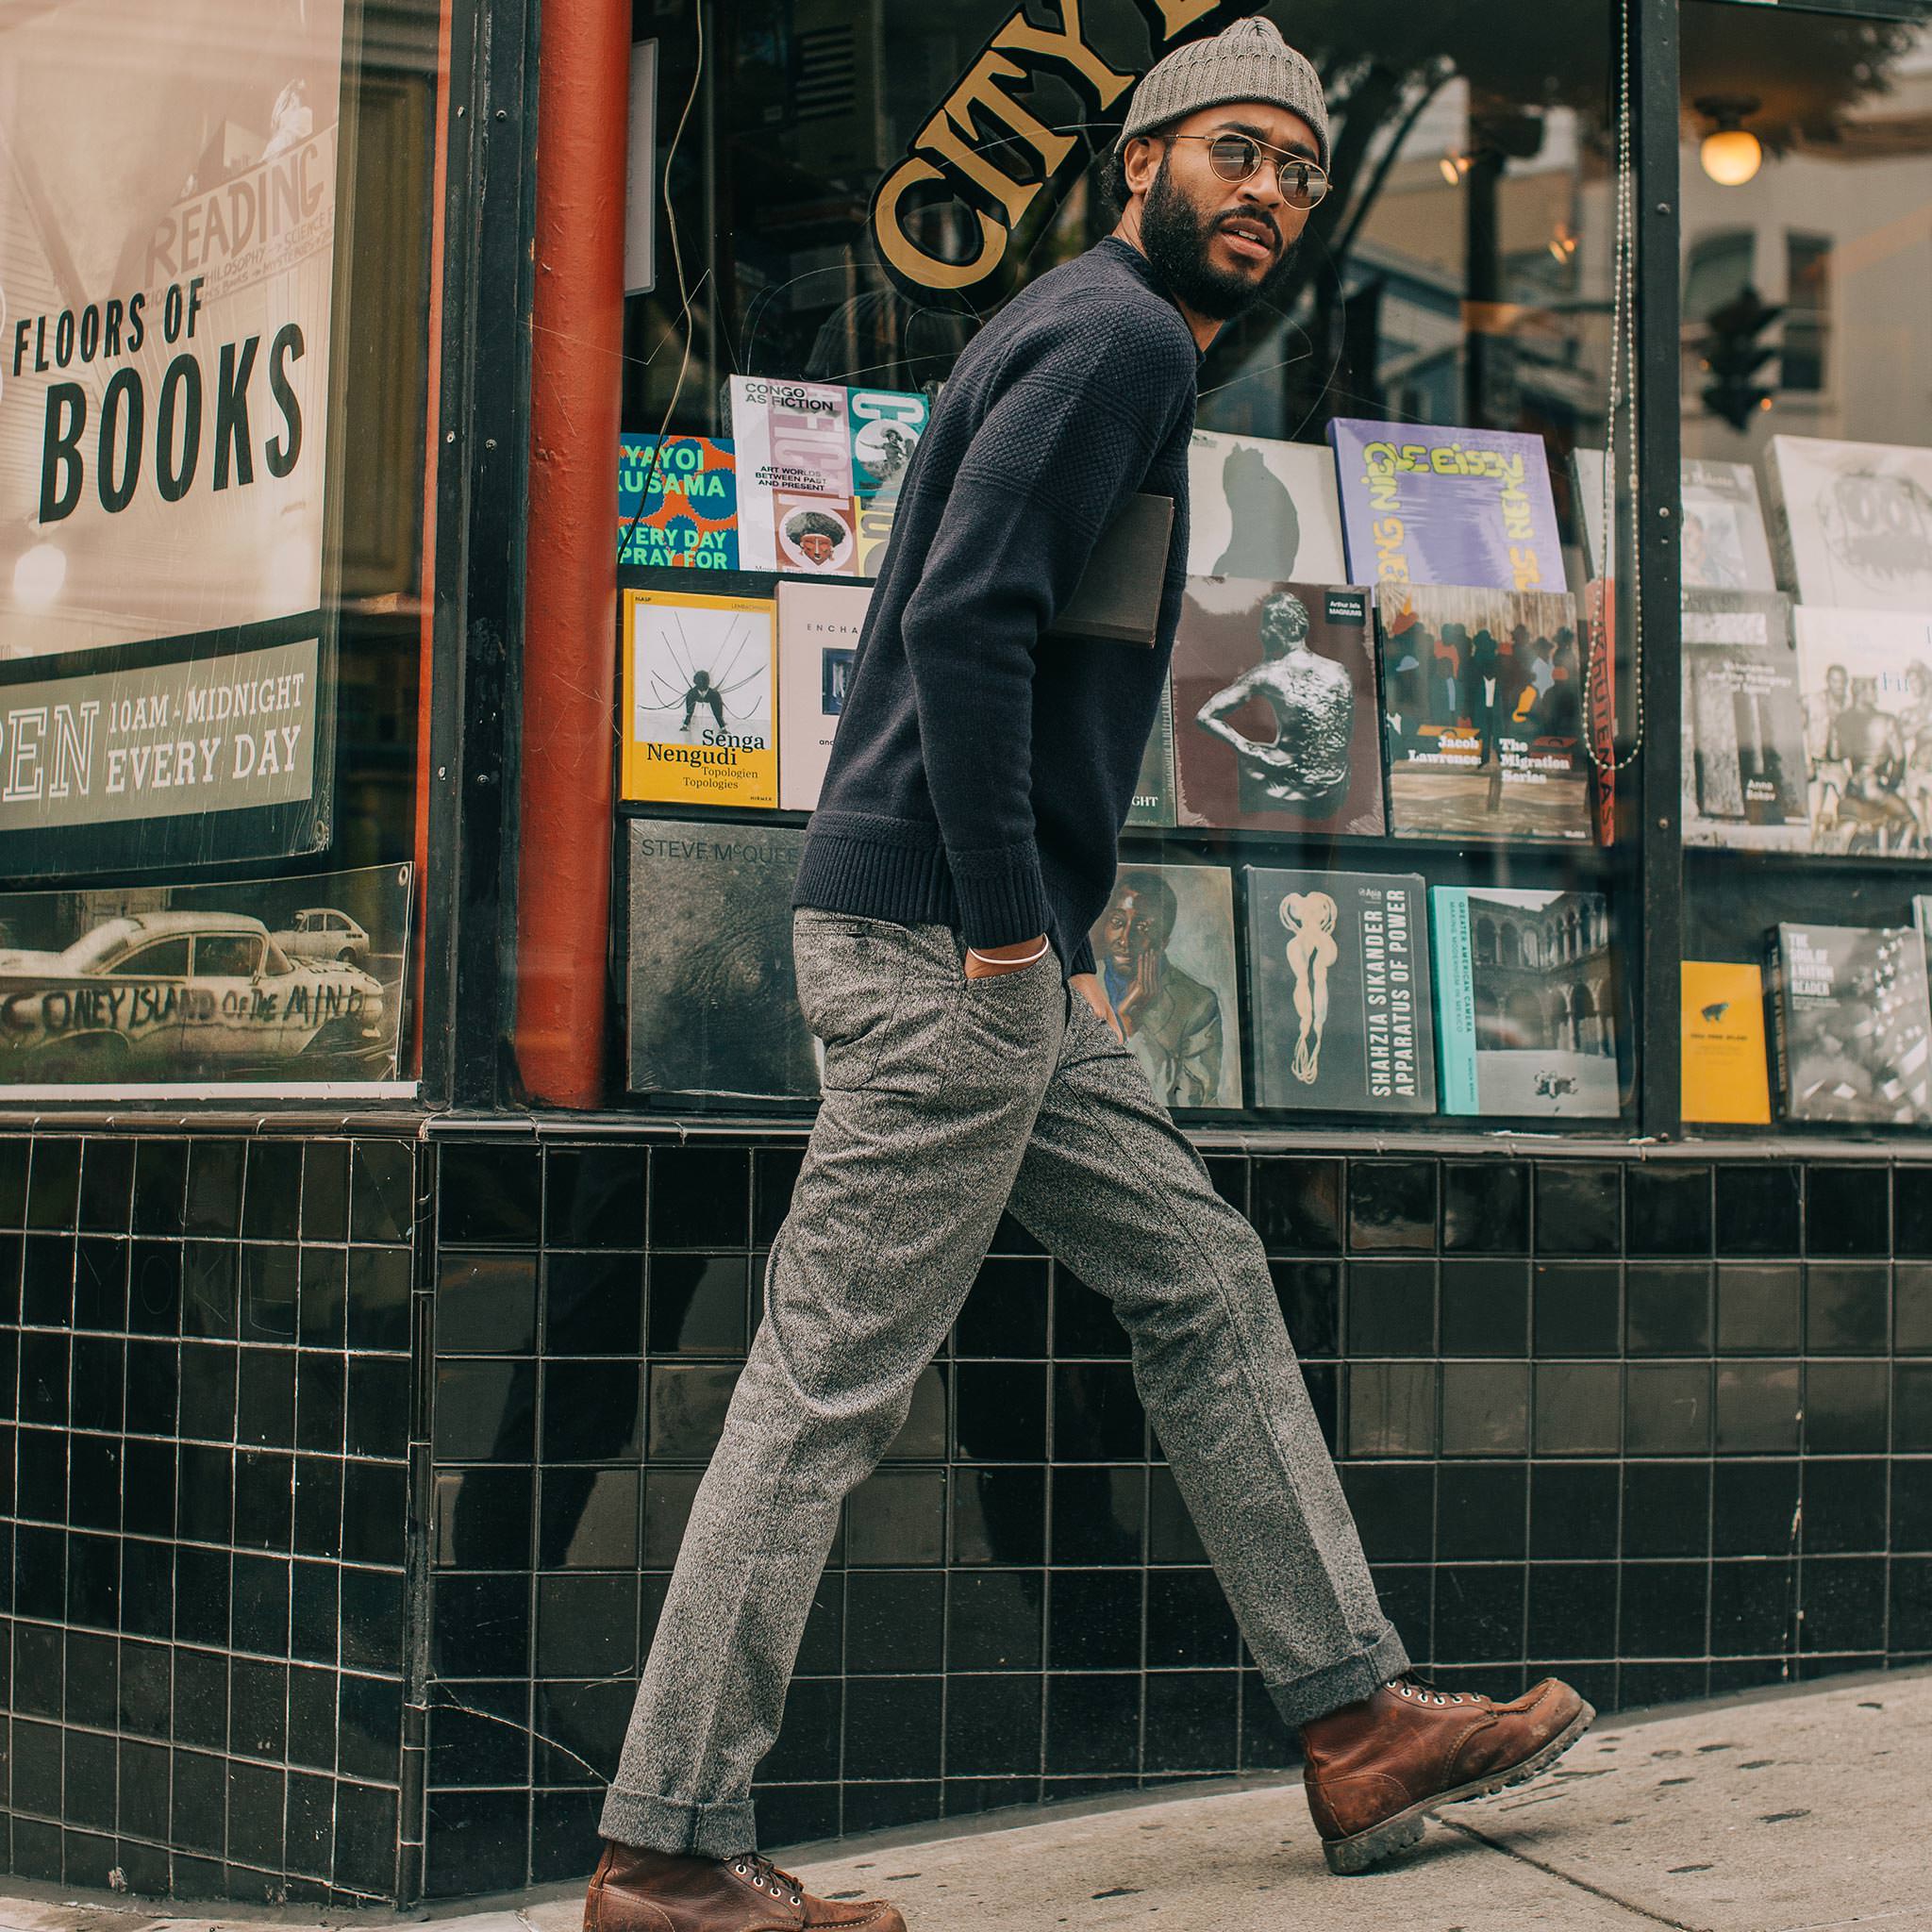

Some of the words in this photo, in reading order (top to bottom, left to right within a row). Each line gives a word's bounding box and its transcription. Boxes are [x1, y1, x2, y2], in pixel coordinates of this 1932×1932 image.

[875, 0, 1135, 289] CITY
[144, 142, 324, 289] READING
[13, 292, 145, 376] FLOORS
[164, 276, 205, 343] OF
[745, 383, 806, 397] CONGO
[745, 393, 767, 404] AS
[772, 396, 834, 411] FICTION
[39, 323, 305, 524] BOOKS
[625, 445, 704, 471] YAYOI
[755, 473, 801, 482] BETWEEN
[804, 476, 826, 485] PAST
[781, 467, 822, 477] WORLDS
[781, 481, 824, 491] PRESENT
[684, 529, 726, 549] DAY
[618, 546, 676, 566] PRAY
[684, 550, 727, 570] FOR
[808, 623, 858, 634] ENCHA
[109, 693, 170, 733] 10AM
[186, 673, 304, 724] MIDNIGHT
[0, 699, 100, 802] EN
[702, 728, 765, 753] Senga
[1438, 735, 1479, 749] Jacob
[1498, 738, 1528, 752] The
[106, 738, 221, 793] EVERY
[233, 724, 302, 779] DAY
[647, 742, 738, 768] Nengudi
[1500, 754, 1571, 770] Migration
[683, 776, 739, 791] Topologies
[701, 766, 758, 779] Topologien
[1501, 770, 1547, 784] Series
[1131, 795, 1159, 808] GHT
[641, 839, 708, 858] STEVE
[1387, 890, 1407, 953] POWER
[1364, 909, 1388, 1006] SIKANDER
[1461, 945, 1471, 992] AMERICAN
[1390, 960, 1409, 982] OF
[2, 987, 125, 1031] CONEY
[129, 985, 216, 1026] ISLAND
[283, 984, 363, 1027] MIND
[1463, 995, 1473, 1033] CAMERA
[1369, 1012, 1391, 1097] SHAHZIA
[1391, 989, 1415, 1096] APPARATUS
